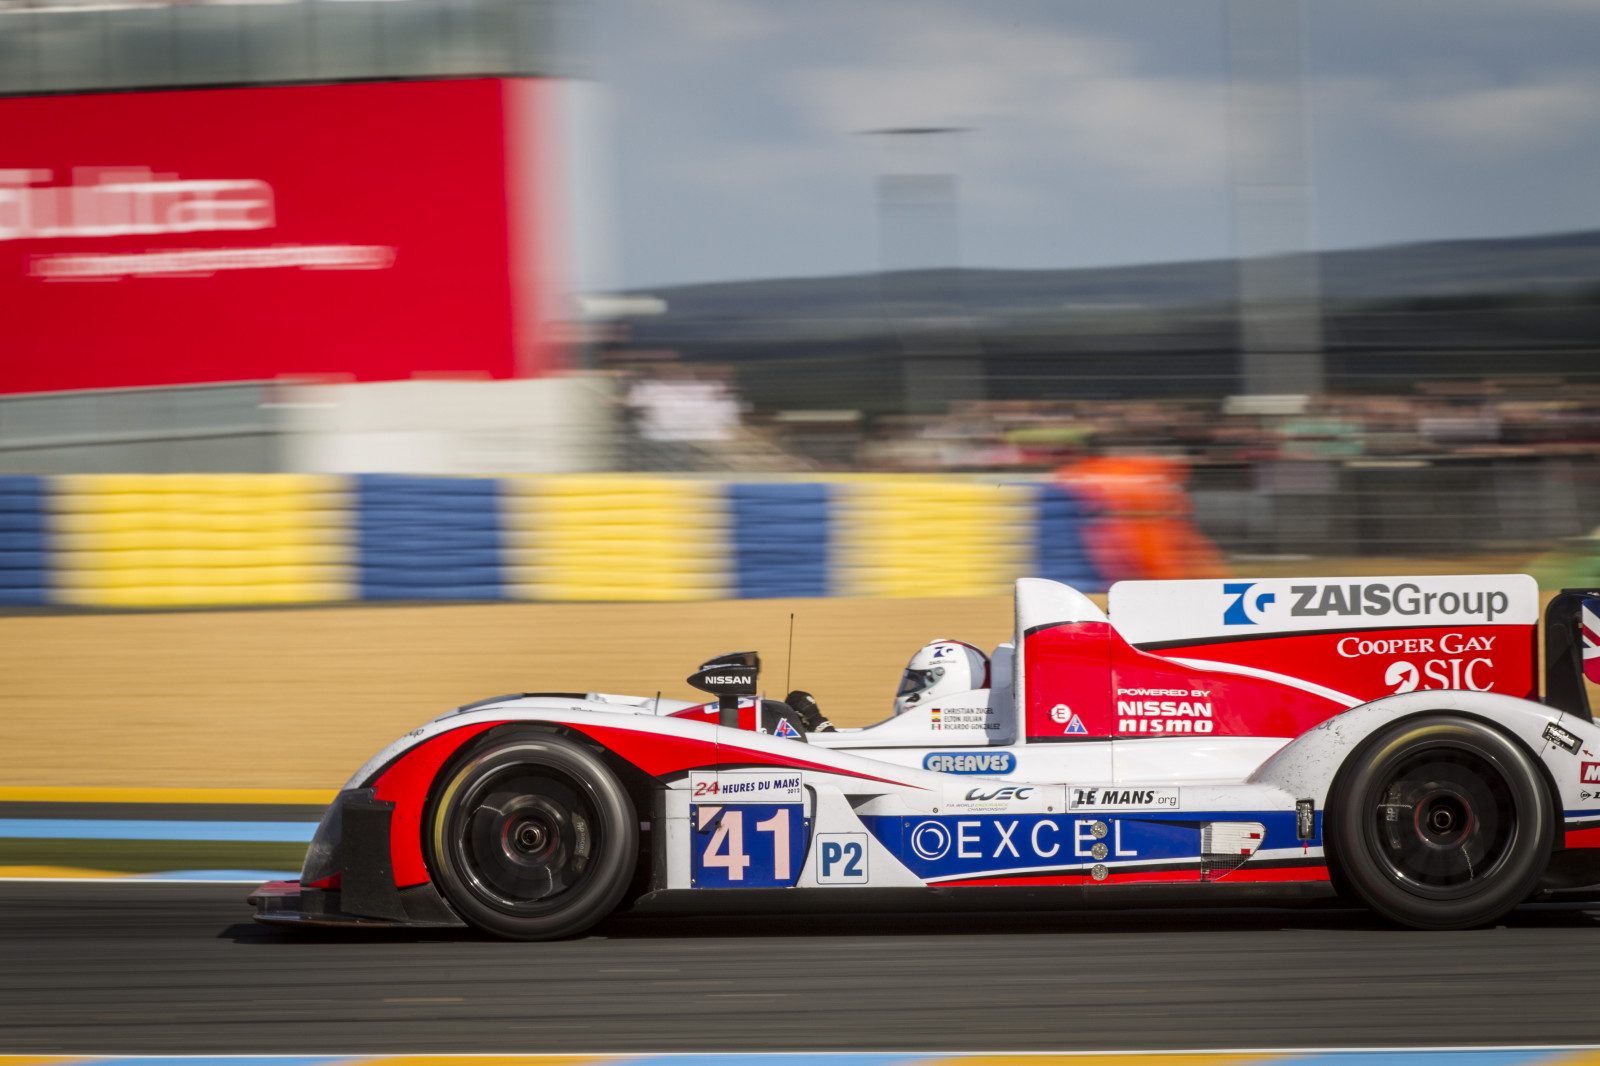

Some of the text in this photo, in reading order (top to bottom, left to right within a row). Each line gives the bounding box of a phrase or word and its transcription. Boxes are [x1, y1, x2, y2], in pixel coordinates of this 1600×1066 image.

[1290, 583, 1509, 622] ZAISGroup
[1336, 633, 1496, 658] COOPER GAY
[704, 676, 752, 685] NISSAN
[1423, 657, 1495, 692] SIC
[1117, 688, 1211, 697] POWERED BY
[943, 707, 975, 715] CHRISTIAN
[1117, 701, 1213, 717] NISSAN
[943, 715, 983, 723] ELTON JULIAN
[926, 754, 1010, 772] GREAVES
[693, 778, 800, 797] 24 HEURES DU MANS
[964, 786, 1035, 801] WEC
[1076, 790, 1097, 805] LE
[1100, 790, 1155, 805] MANS
[702, 808, 791, 881] 41
[957, 819, 1138, 859] EXCEL
[821, 841, 863, 878] P2
